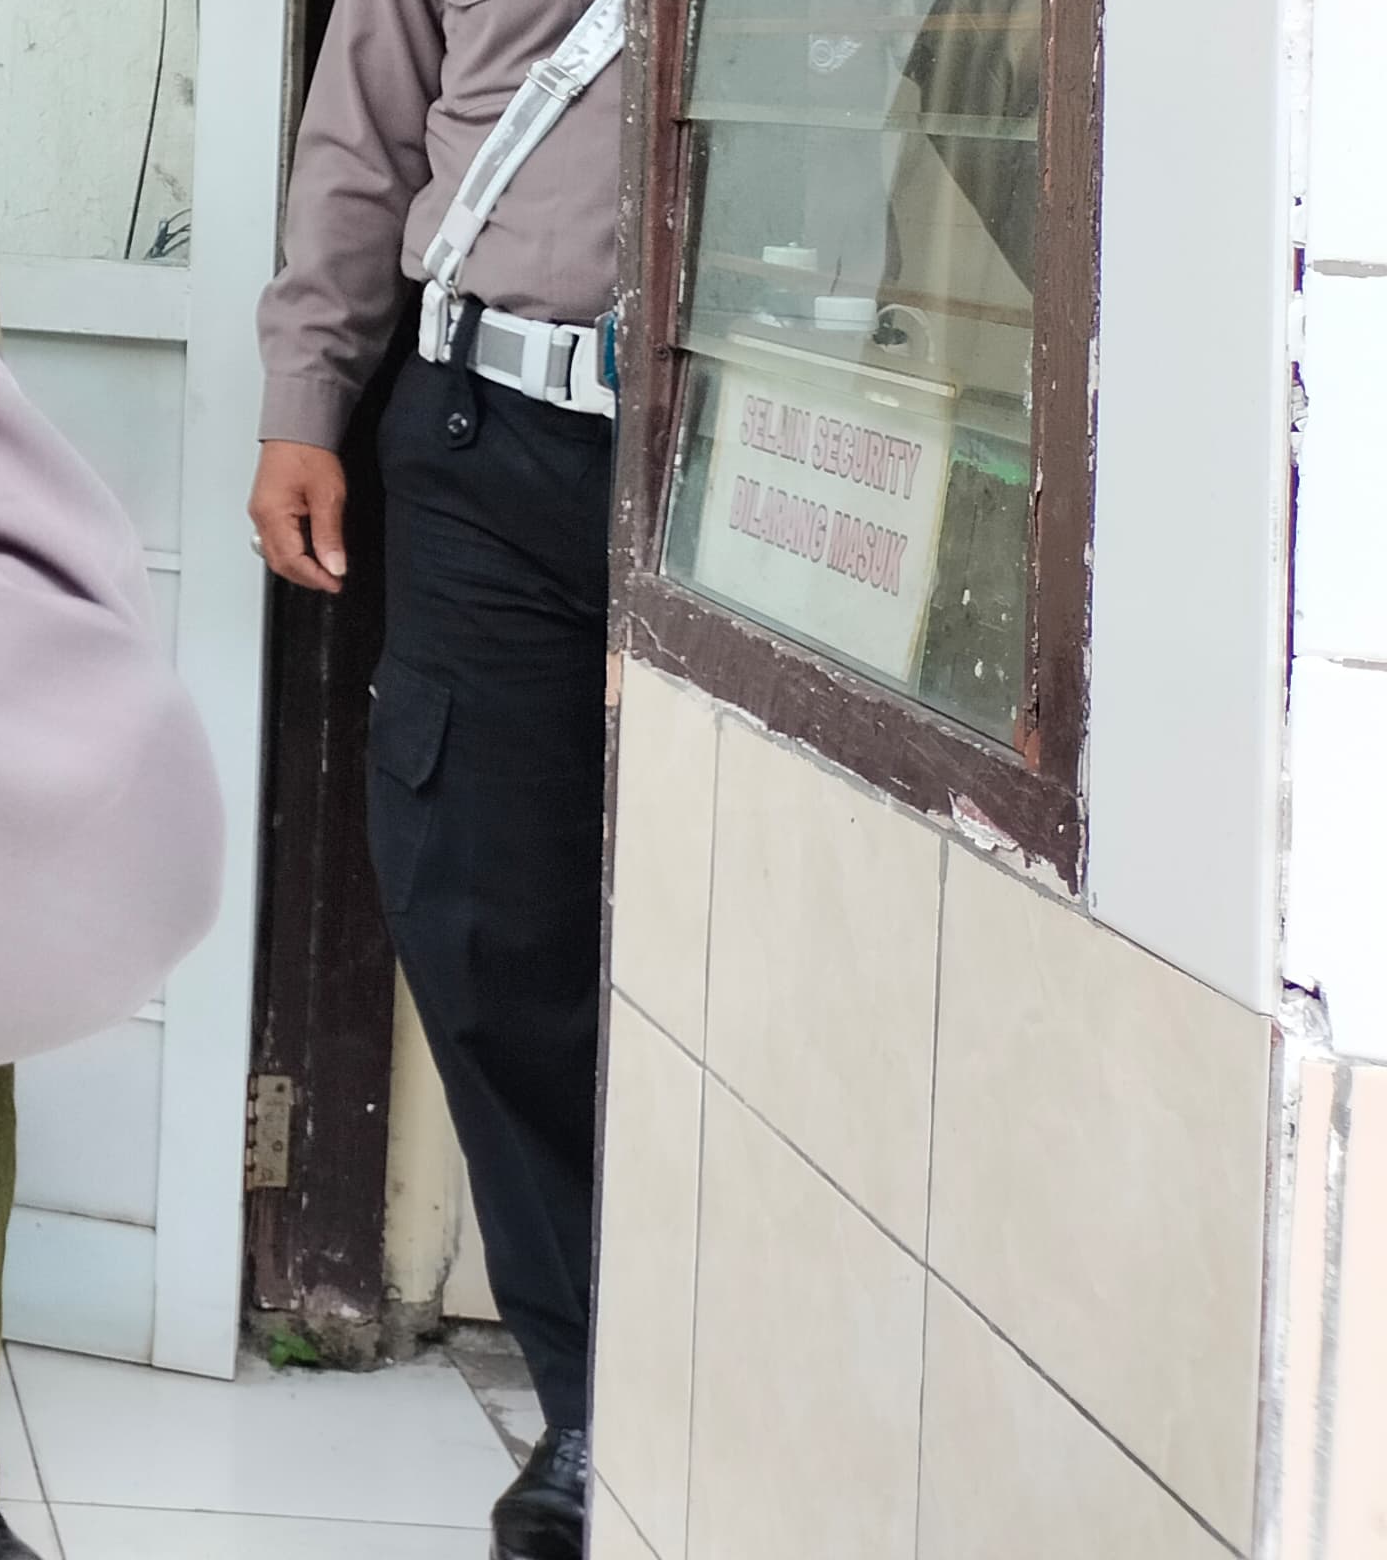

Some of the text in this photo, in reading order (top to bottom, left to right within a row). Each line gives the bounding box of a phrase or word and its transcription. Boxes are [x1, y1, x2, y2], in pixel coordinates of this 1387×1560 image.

[740, 395, 921, 500] SELAIN SECURITY
[729, 474, 908, 597] DILARANG MASUK
